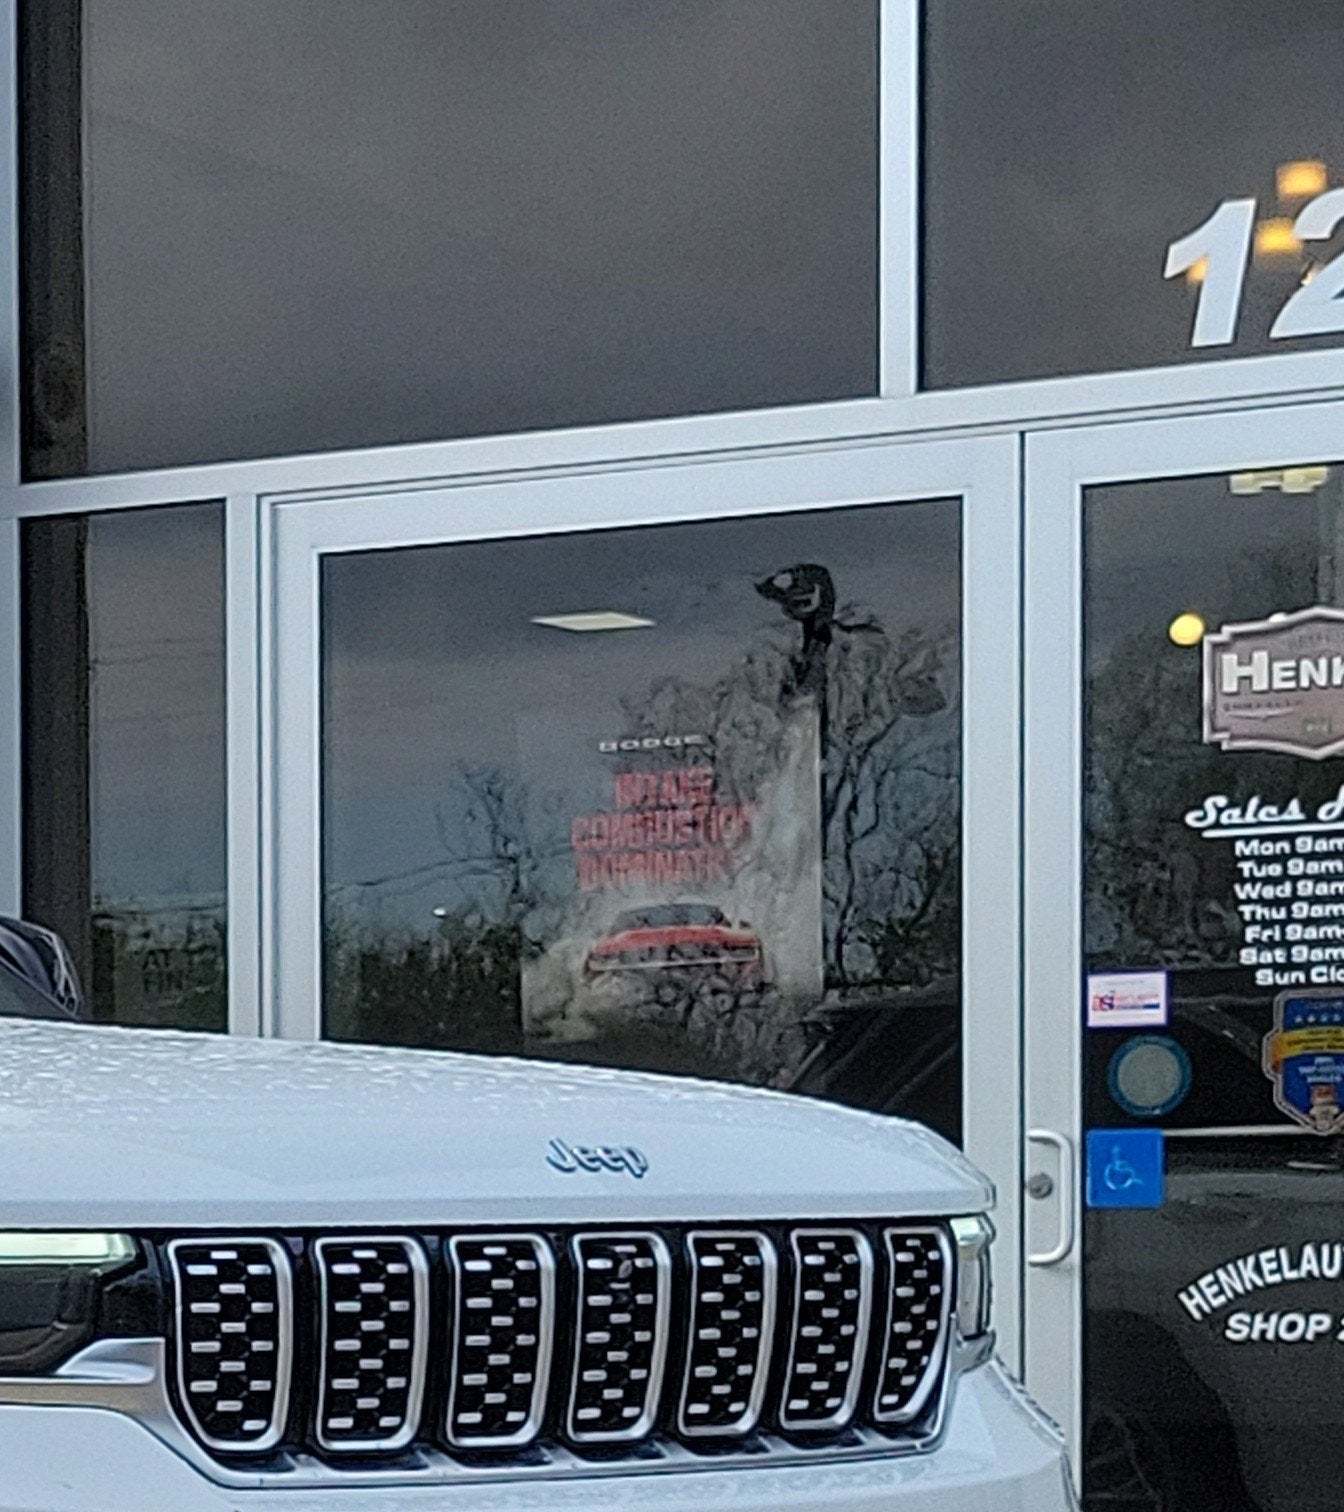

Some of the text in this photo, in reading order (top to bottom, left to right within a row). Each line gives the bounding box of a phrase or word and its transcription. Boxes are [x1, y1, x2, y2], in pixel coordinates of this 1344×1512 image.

[1185, 795, 1306, 828] Sales
[1234, 838, 1291, 857] Mon
[1237, 860, 1283, 878] Tue
[1233, 879, 1292, 900] Wed
[1238, 903, 1287, 921] Thu
[1244, 924, 1282, 943] Fri
[1239, 947, 1287, 965] Sat
[1255, 968, 1306, 986] Sun
[546, 1138, 649, 1179] Jeep
[1177, 1242, 1344, 1321] HENKELAU
[1224, 1312, 1332, 1342] SHOP
